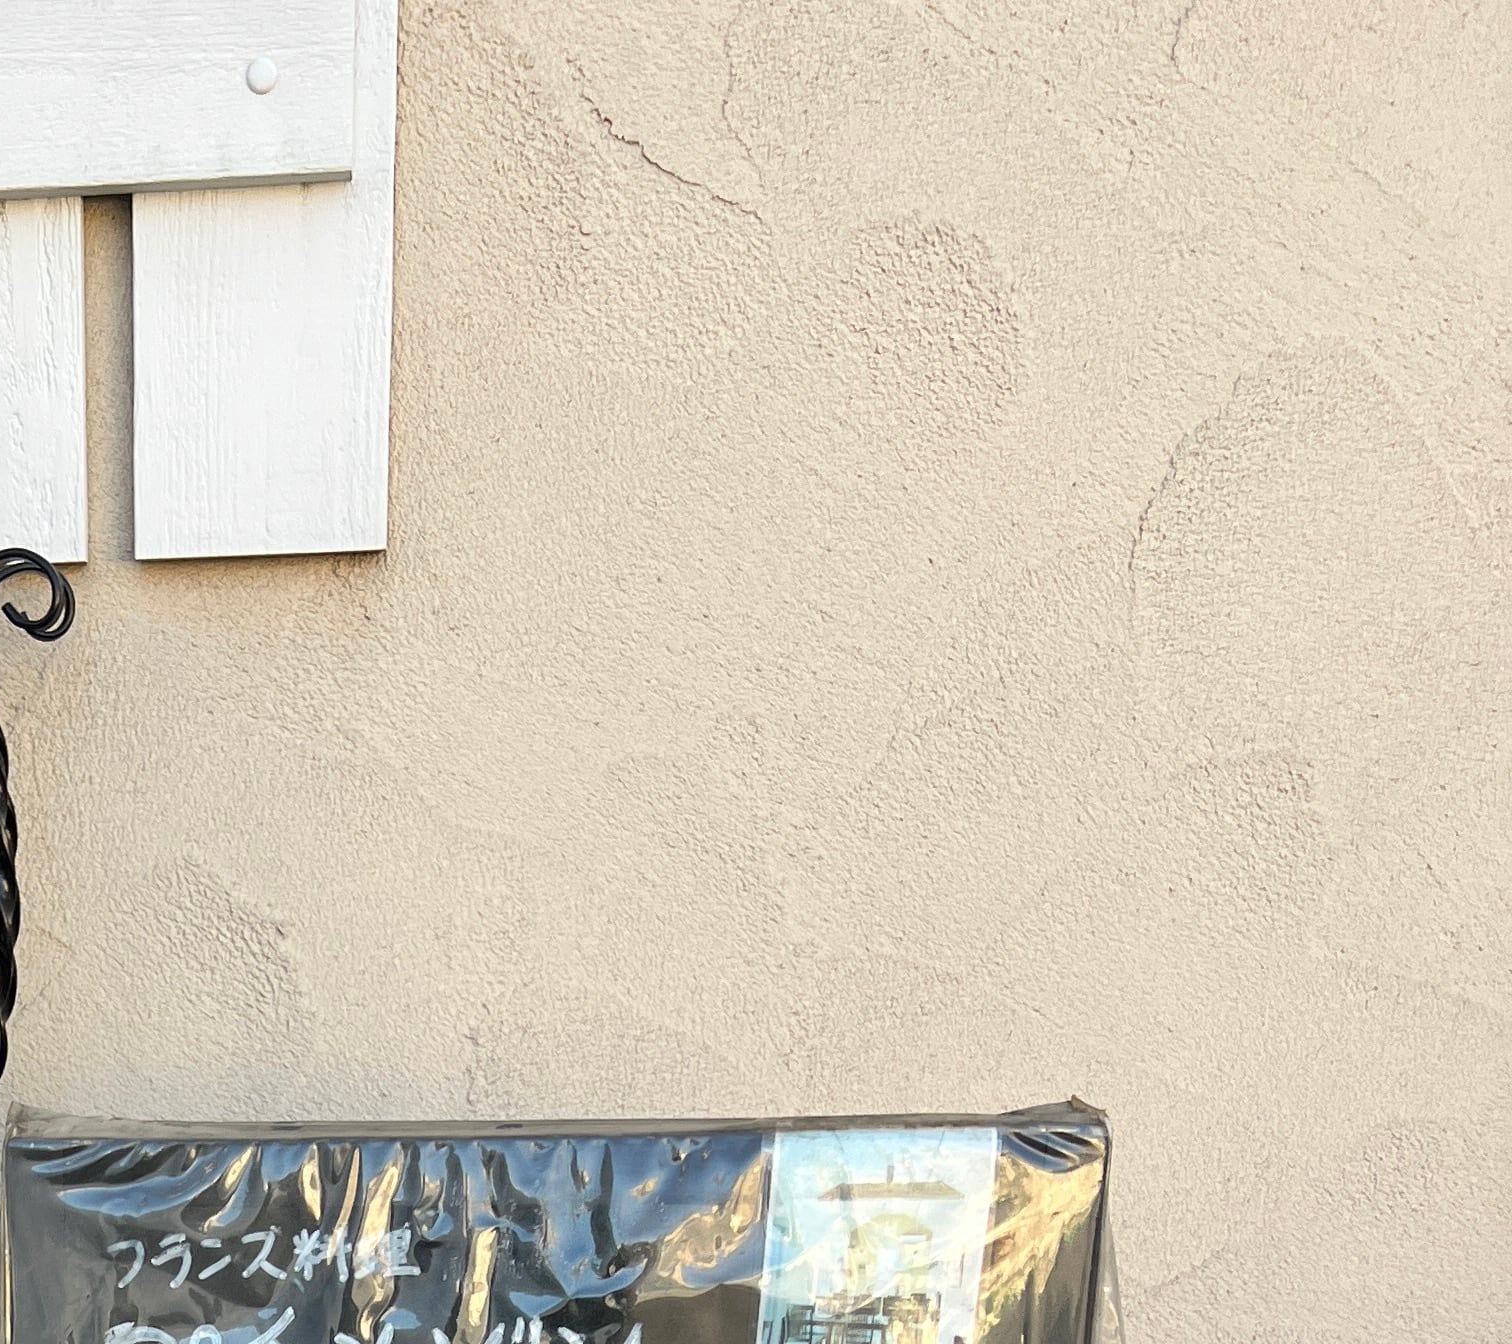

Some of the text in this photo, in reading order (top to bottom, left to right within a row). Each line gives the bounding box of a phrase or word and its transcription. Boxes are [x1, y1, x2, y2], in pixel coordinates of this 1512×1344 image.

[107, 1221, 421, 1289] フランス料理
